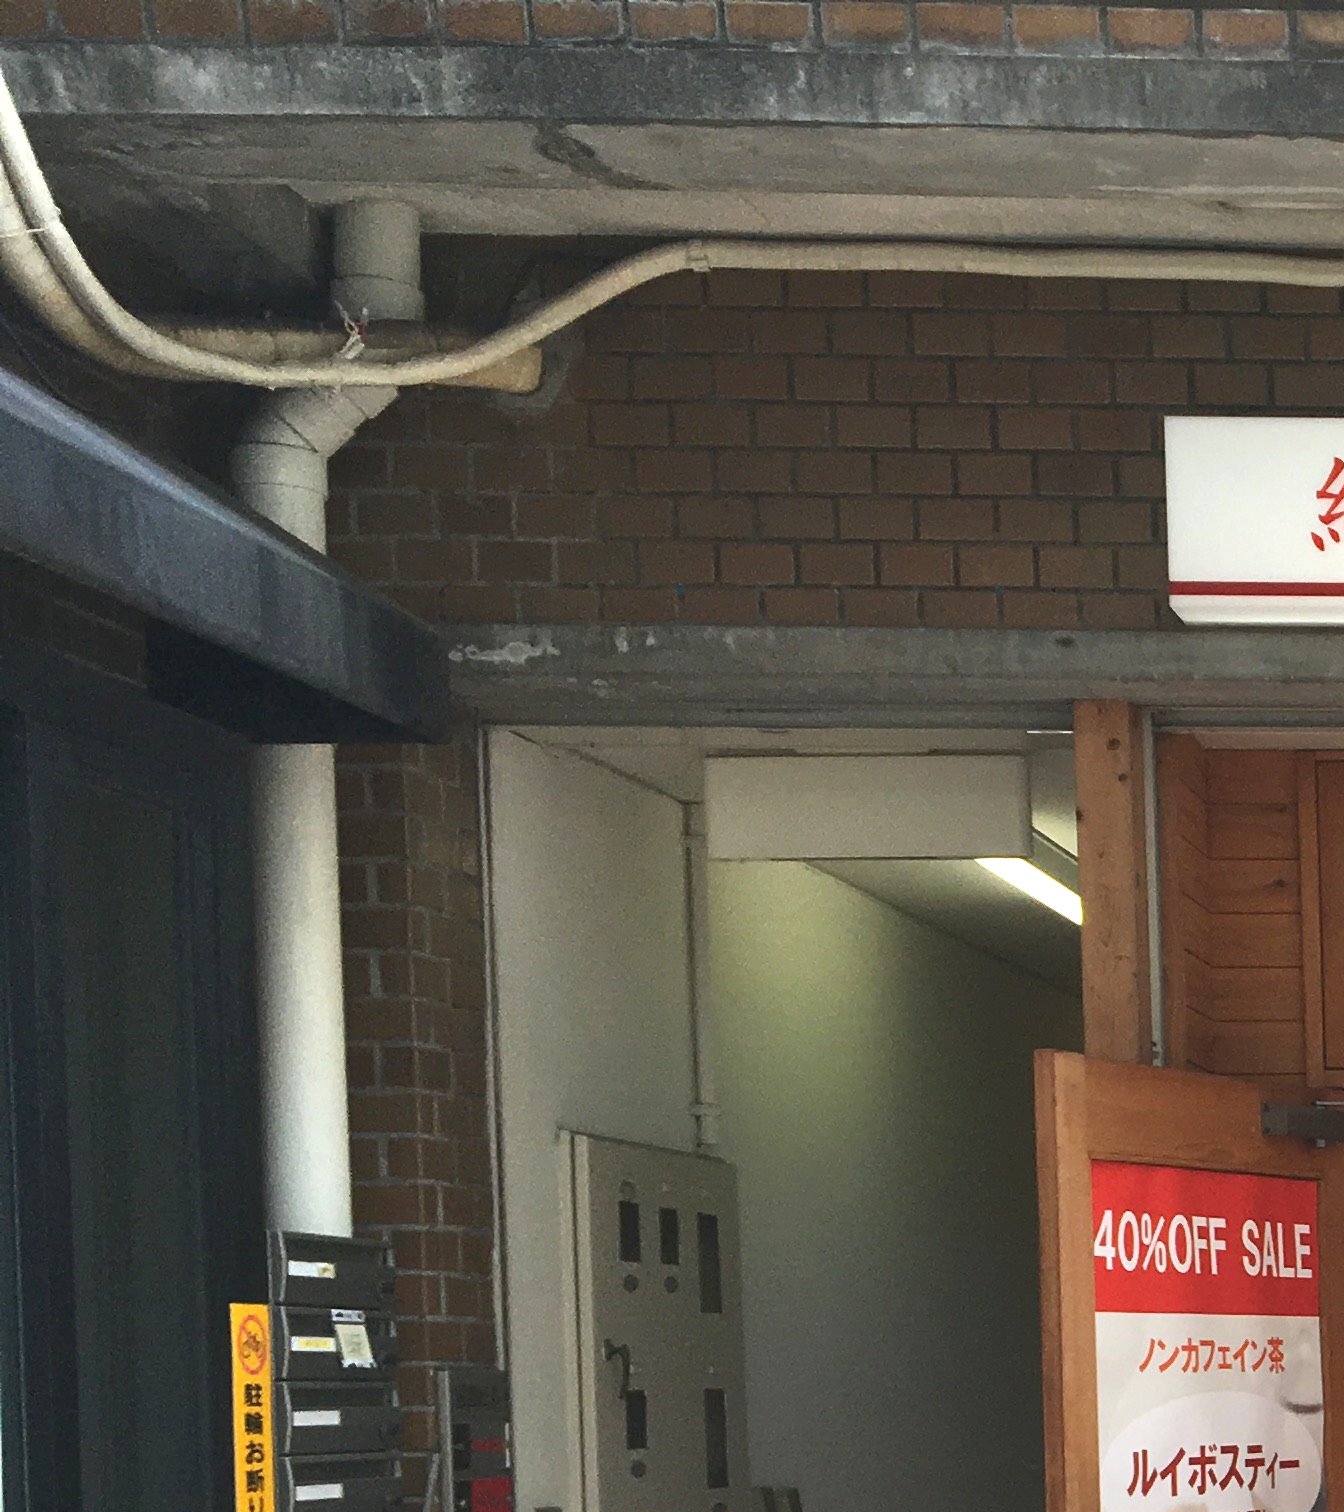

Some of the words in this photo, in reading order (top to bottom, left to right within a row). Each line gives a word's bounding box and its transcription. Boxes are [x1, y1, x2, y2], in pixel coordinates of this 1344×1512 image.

[1093, 1209, 1227, 1276] 40%OFF
[1241, 1220, 1313, 1279] SALE
[1139, 1337, 1286, 1374] ノンカフェイン茶
[1126, 1444, 1301, 1498] ルイボスティー
